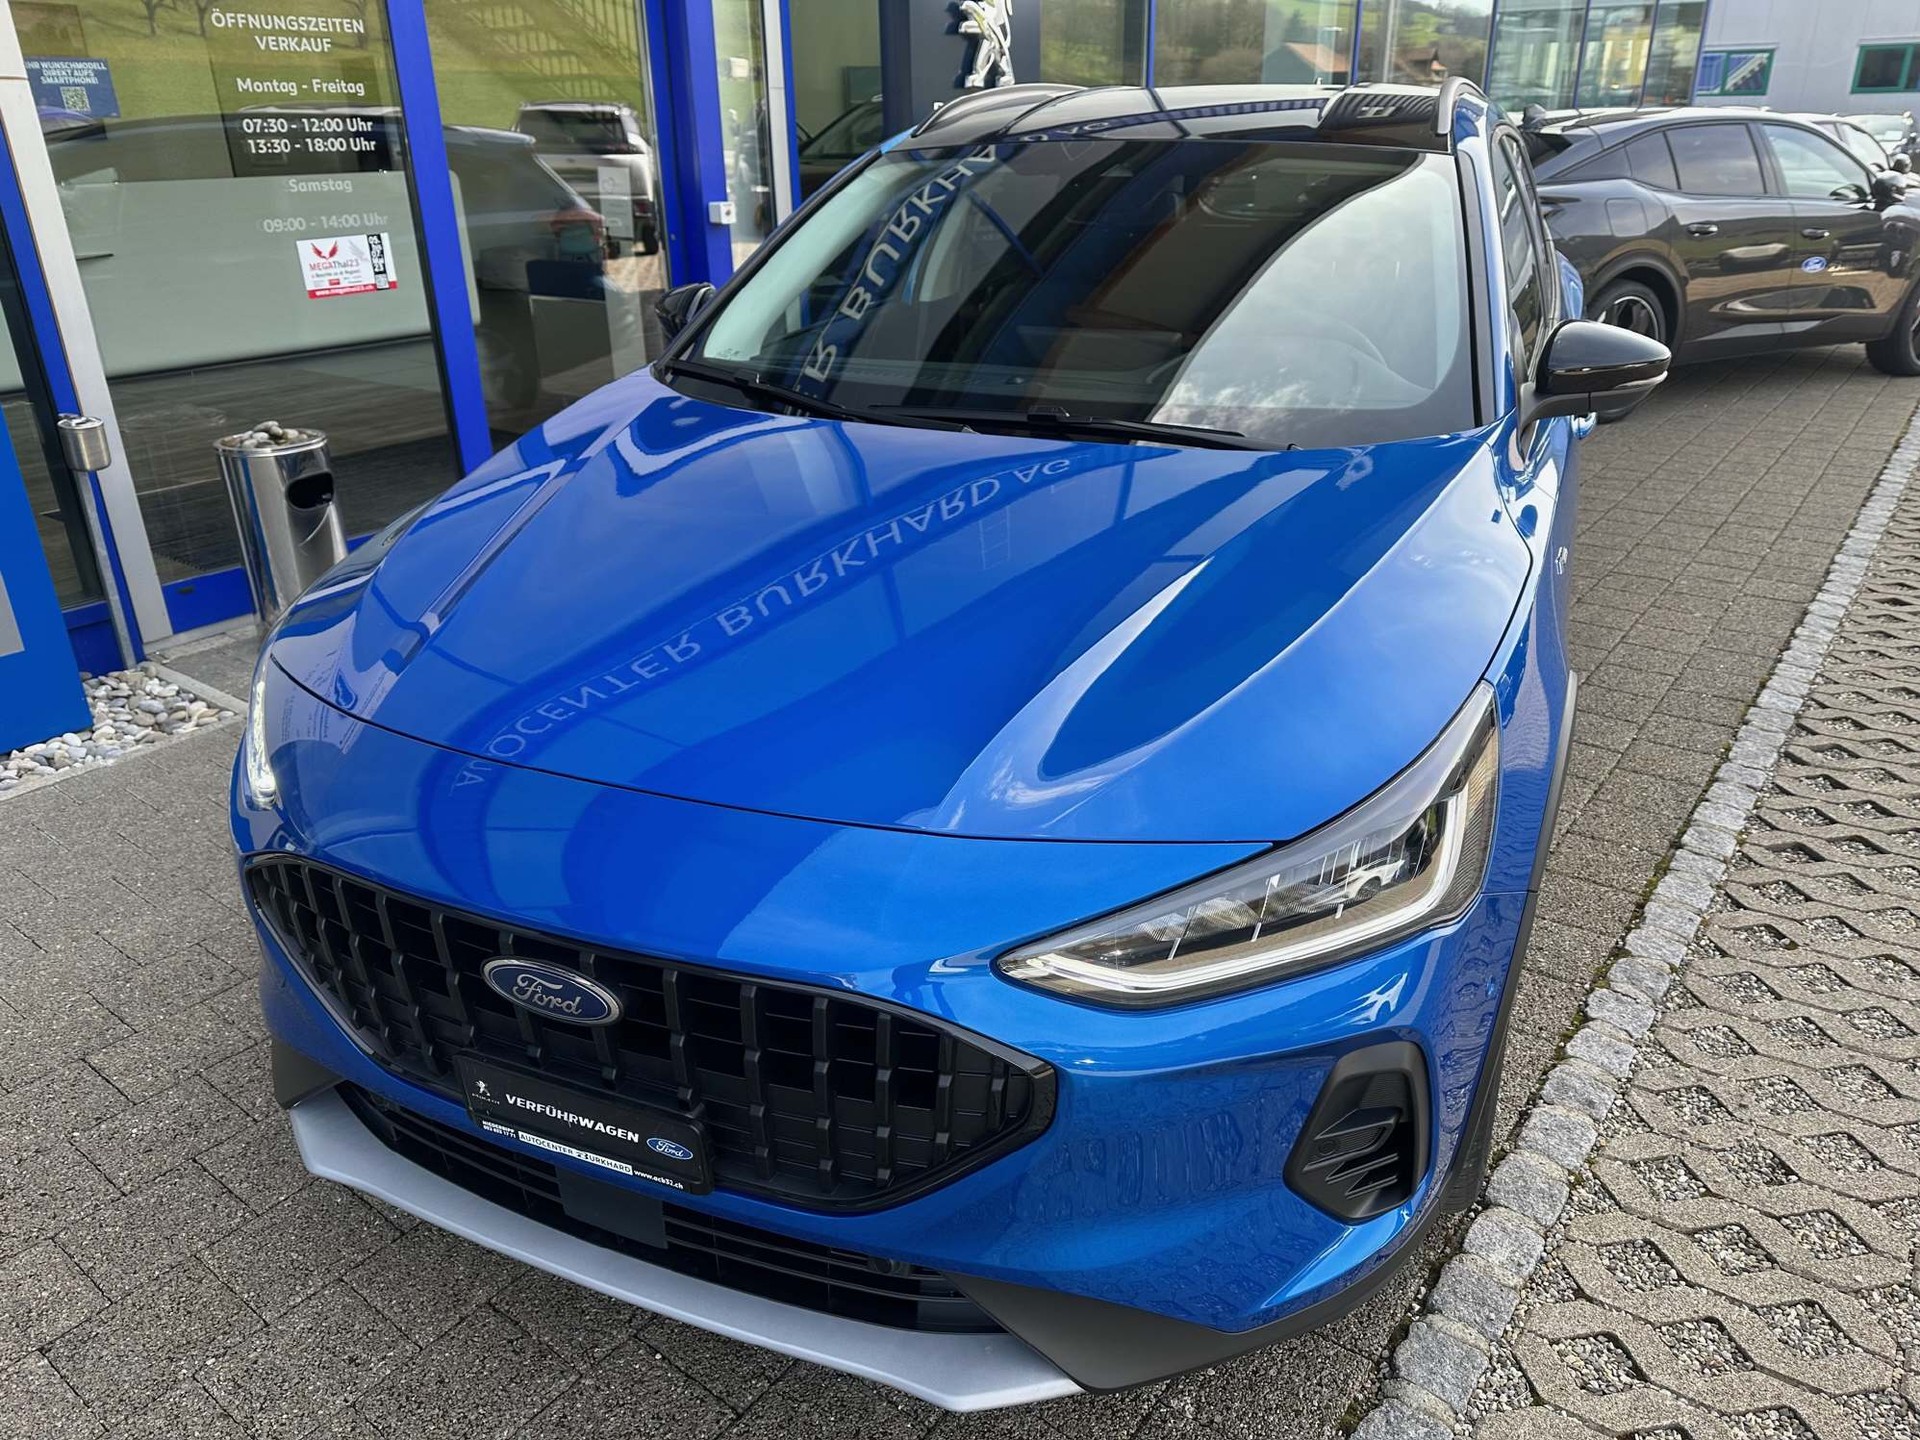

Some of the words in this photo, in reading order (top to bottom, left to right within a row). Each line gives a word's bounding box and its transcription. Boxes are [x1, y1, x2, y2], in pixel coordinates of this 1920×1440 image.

[211, 8, 364, 33] ÖFFNUNGSZEITEN
[254, 35, 332, 52] VERKAUF
[236, 77, 298, 96] Montag
[312, 78, 365, 97] Freitag
[242, 118, 288, 133] 07:30
[301, 118, 343, 133] 12:00
[347, 117, 373, 132] Uhr
[247, 138, 291, 154] 13:30
[305, 137, 346, 152] 18:00
[350, 137, 376, 151] Uhr
[288, 178, 353, 193] Samstag
[263, 218, 306, 233] 09:00
[321, 214, 360, 229] 14:00
[363, 212, 389, 226] Uhr
[512, 973, 582, 1015] Ford
[505, 1093, 640, 1143] VERFÜHRWAGEN
[520, 1133, 574, 1155] AUTOCENTER
[656, 1140, 684, 1157] Ford
